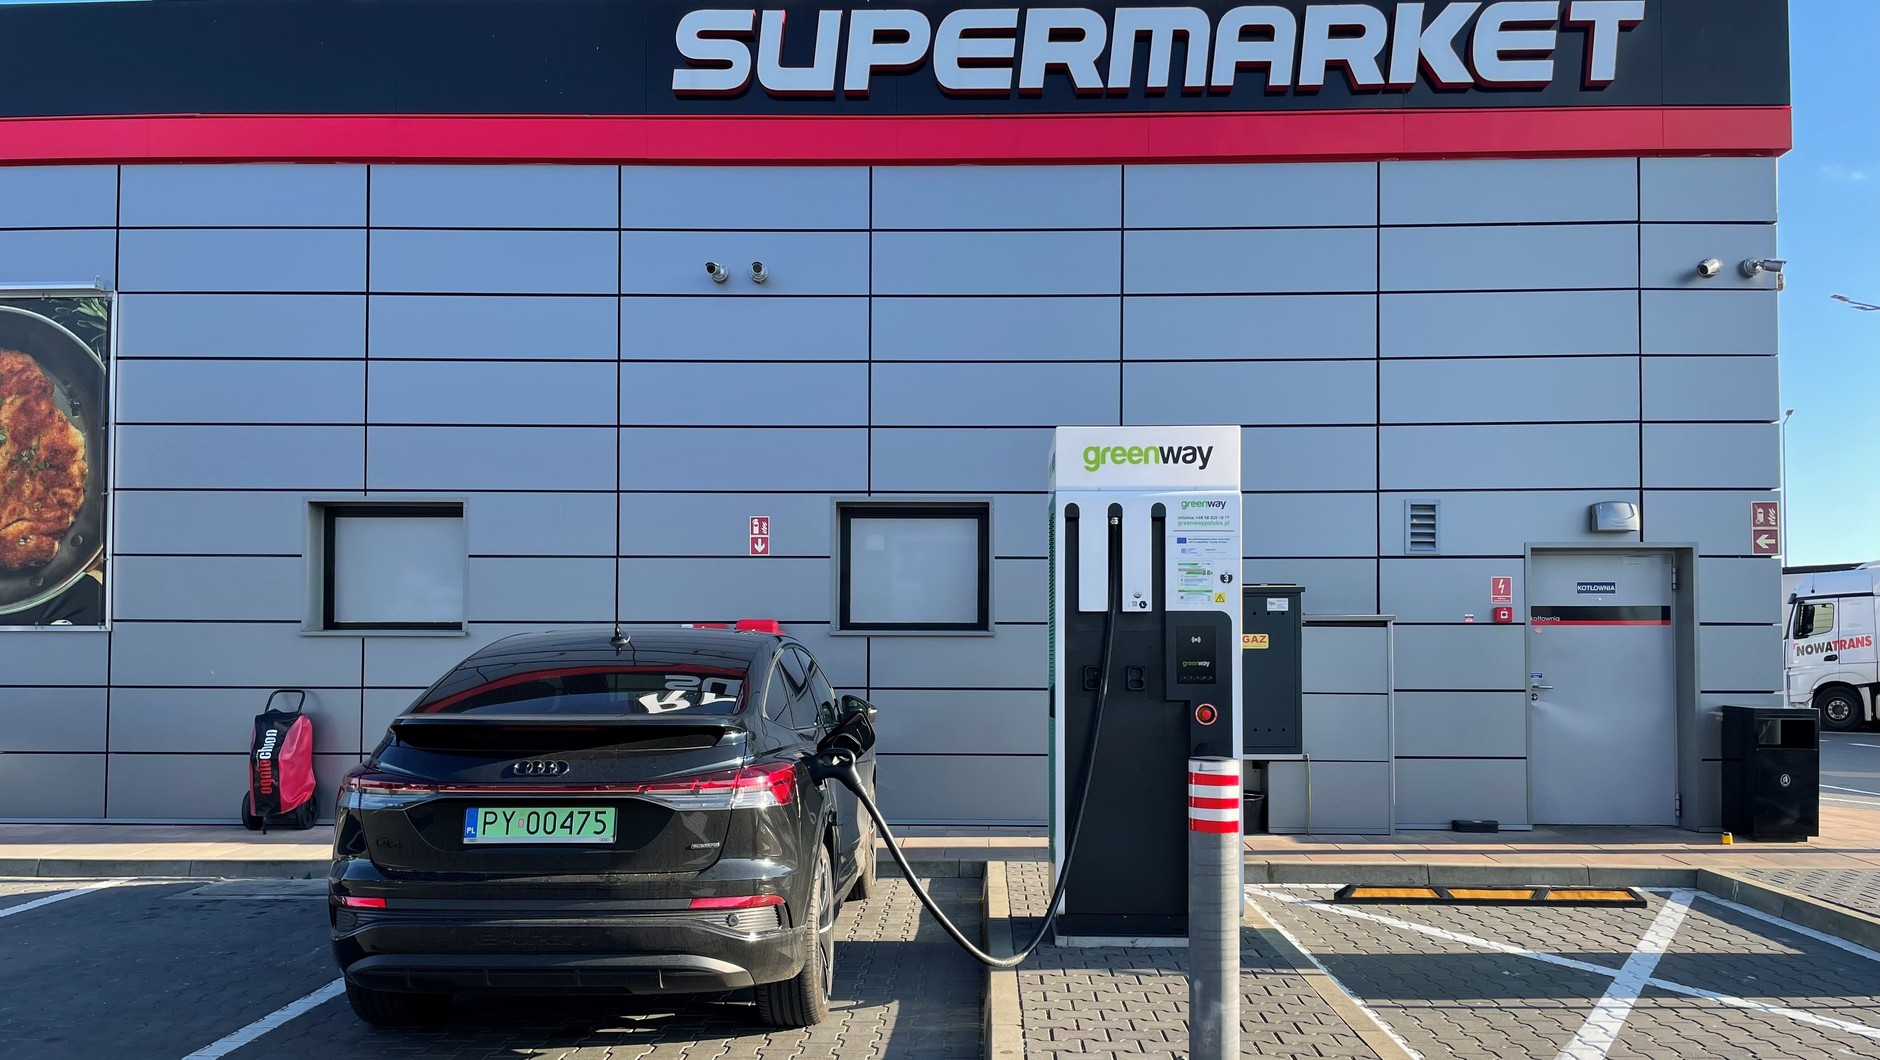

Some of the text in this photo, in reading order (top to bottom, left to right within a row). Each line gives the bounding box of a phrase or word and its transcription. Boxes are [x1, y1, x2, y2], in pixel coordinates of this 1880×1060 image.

[671, 1, 1645, 92] SUPERMARKET
[1083, 445, 1213, 472] greenway
[1181, 500, 1226, 510] greenway
[1242, 635, 1267, 643] GAZ
[1797, 636, 1873, 656] NOWATRANS
[482, 811, 516, 836] PY
[526, 811, 607, 836] 00475
